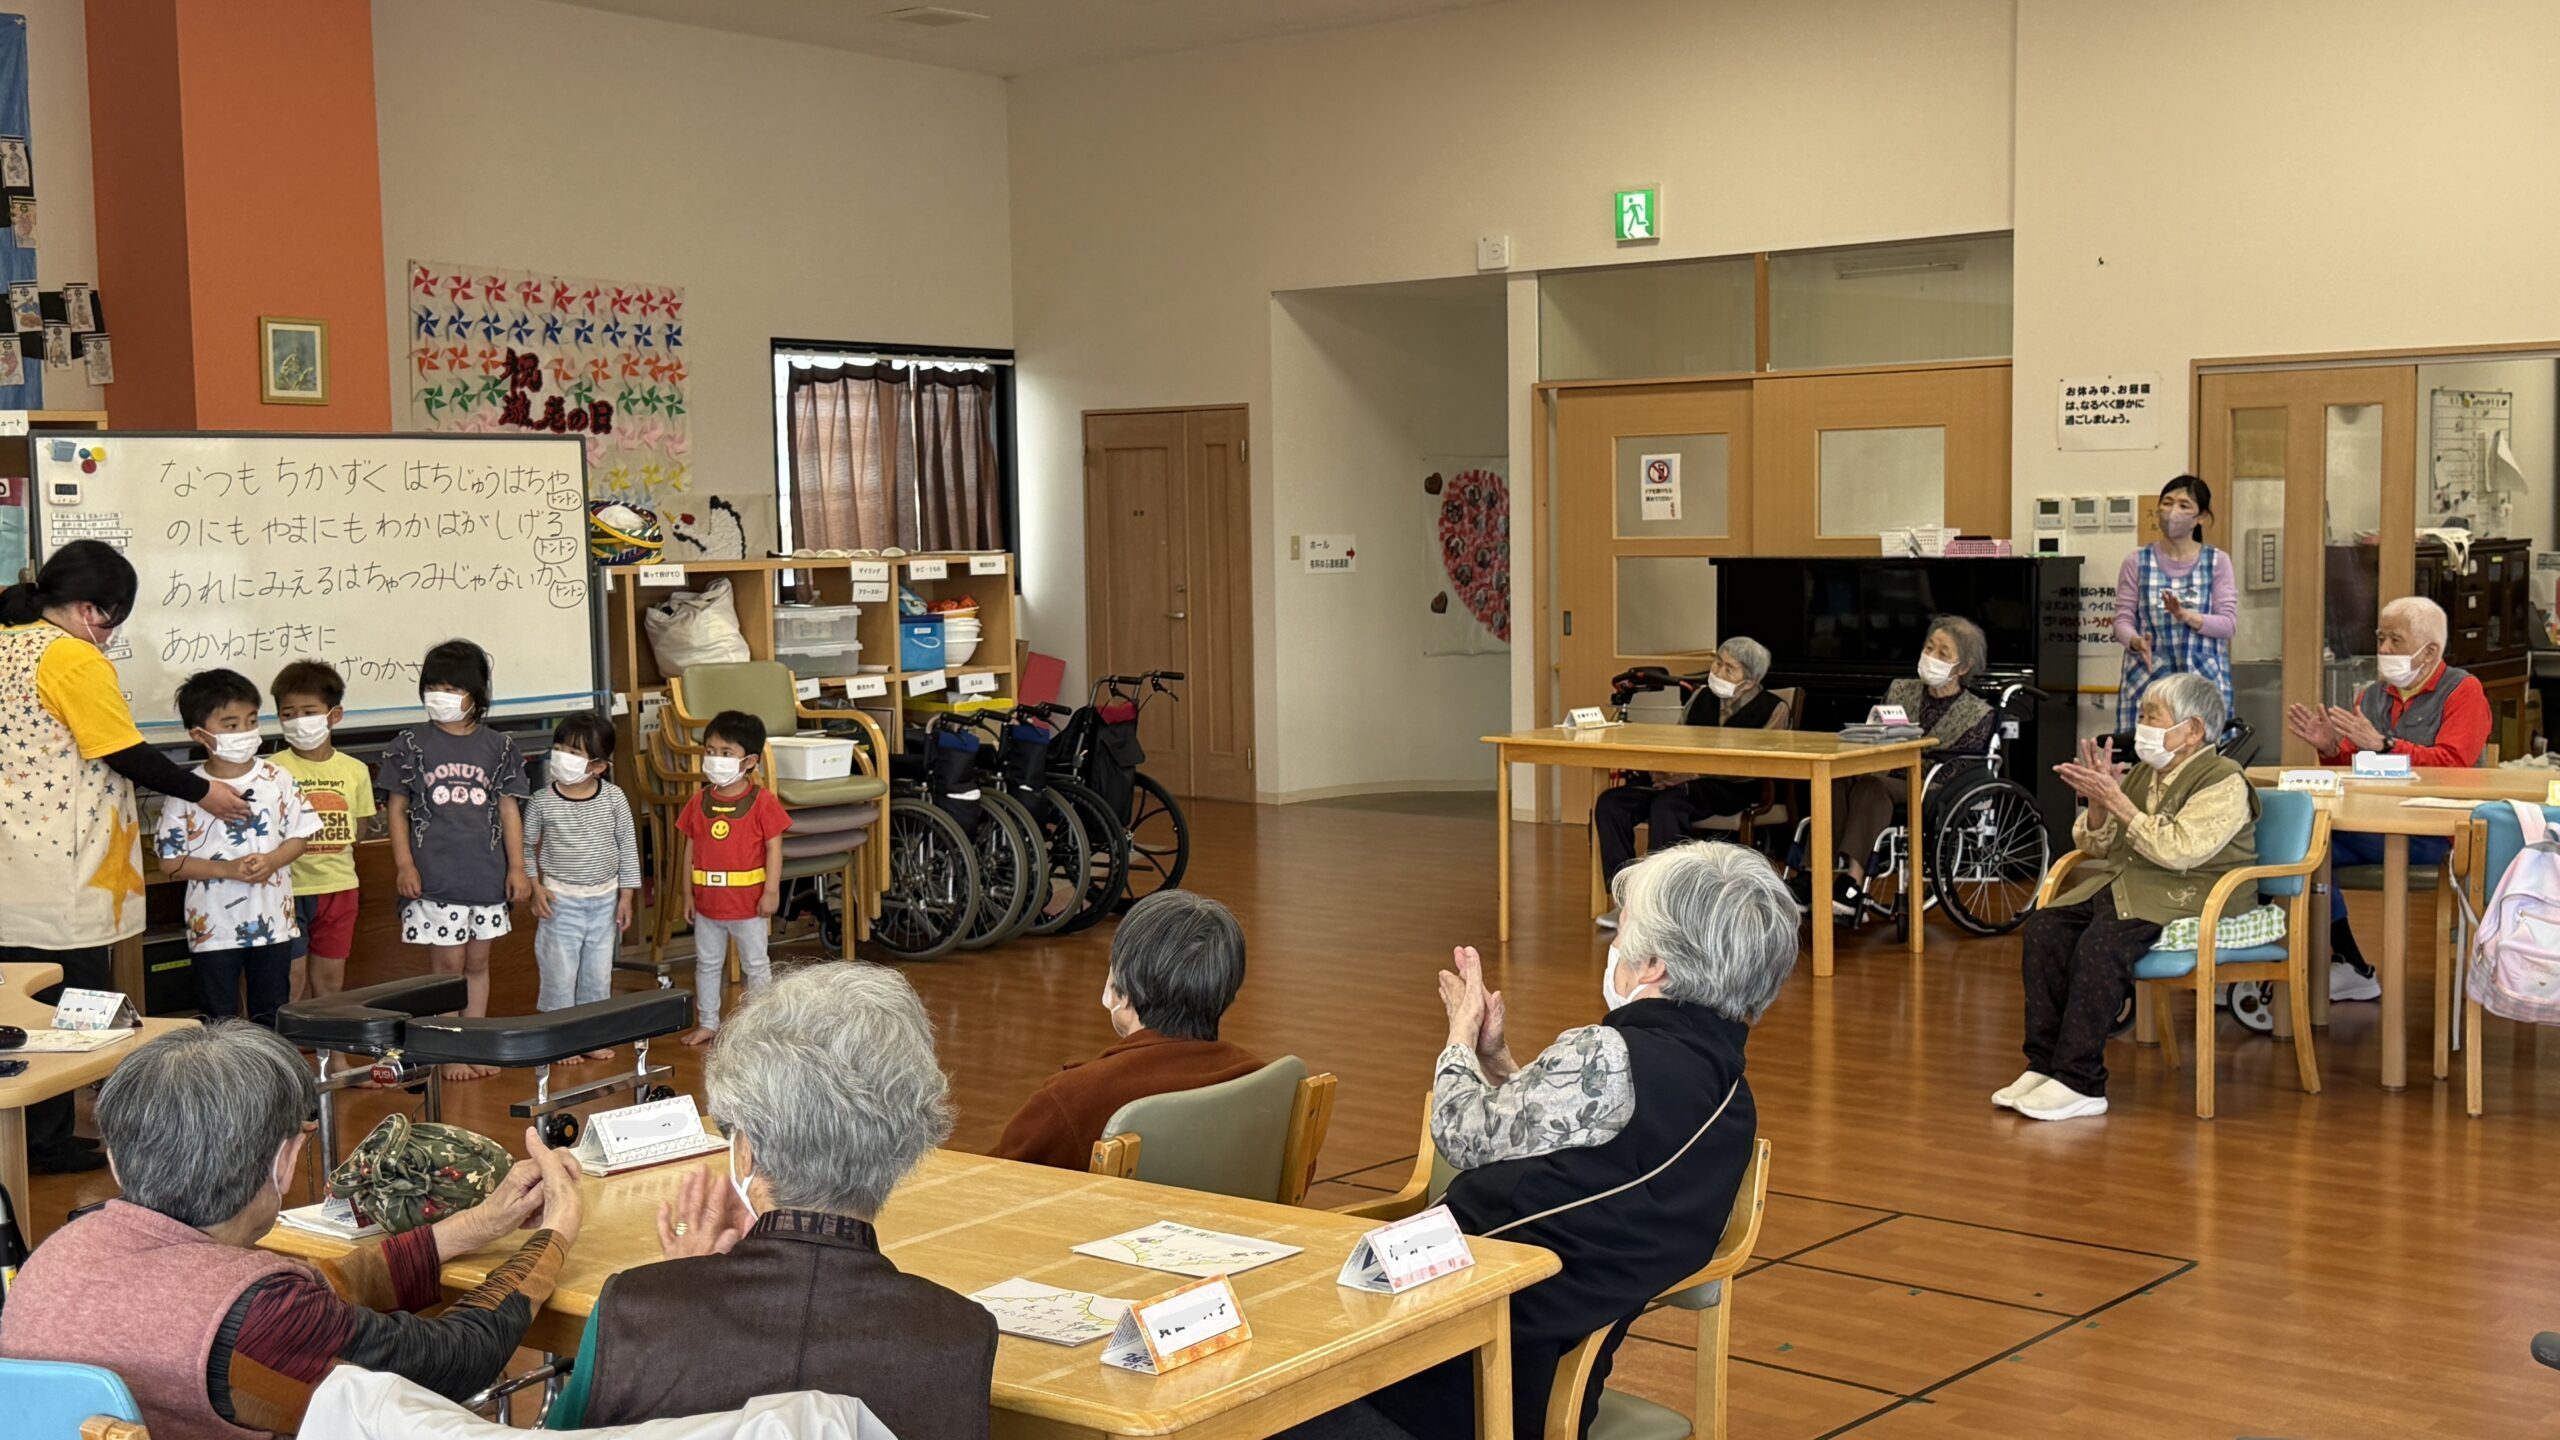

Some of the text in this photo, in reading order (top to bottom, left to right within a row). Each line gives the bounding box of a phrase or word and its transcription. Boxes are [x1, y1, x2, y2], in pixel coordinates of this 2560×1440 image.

[2066, 384, 2150, 396] お休み中、お昼寝
[2065, 399, 2144, 411] は、なるべく静かに
[2065, 414, 2130, 425] 過ごしましょう。
[160, 456, 569, 499] なつも ちかずく はちじゅうはちや
[167, 515, 250, 546] のにも
[261, 512, 367, 544] やまにも
[161, 622, 336, 664] あかねだすきに
[320, 656, 424, 683] げのかさ
[317, 779, 345, 788] burger?
[318, 812, 348, 828] ESH
